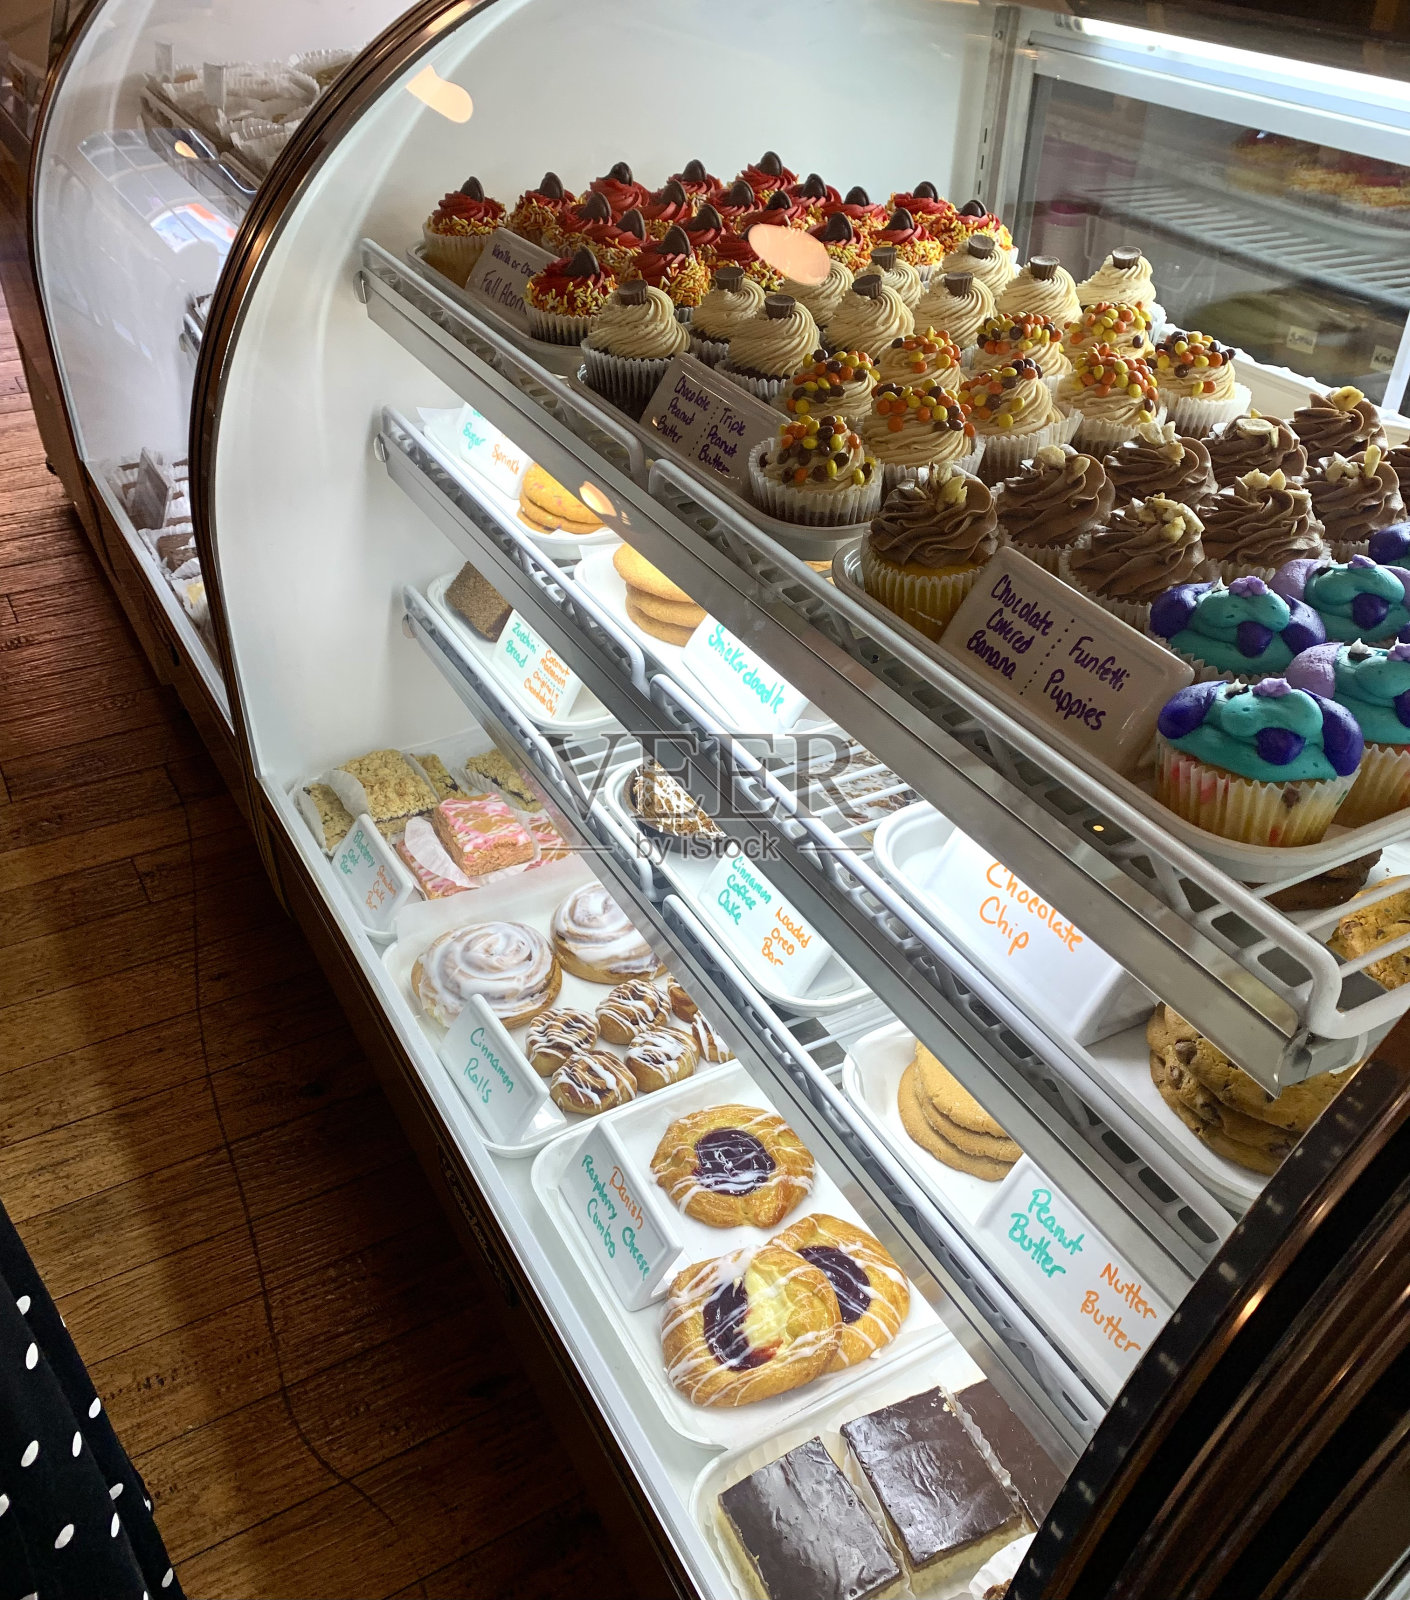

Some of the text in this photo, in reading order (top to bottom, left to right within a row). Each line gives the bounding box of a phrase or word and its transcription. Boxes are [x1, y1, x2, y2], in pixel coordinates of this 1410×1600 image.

[480, 270, 503, 298] Fall
[511, 260, 520, 270] or
[668, 397, 696, 425] Peanut
[674, 375, 711, 411] Chocolate
[463, 421, 486, 450] Sugar
[657, 415, 683, 443] Butter
[706, 425, 737, 457] Peanut
[720, 408, 745, 436] Triple
[698, 443, 730, 473] Butter
[990, 573, 1054, 636] Chocolate
[505, 639, 528, 668] Bread
[512, 621, 540, 654] Zucchini
[986, 608, 1035, 654] Covered
[966, 629, 1017, 680] Banana
[1068, 635, 1130, 692] Funfetti
[1043, 668, 1106, 731] Puppies
[726, 874, 757, 910] Coffee
[732, 855, 772, 904] Cinnamon
[717, 888, 742, 926] Cake
[775, 906, 812, 948] Loaded
[979, 896, 1029, 956] Chip
[986, 861, 1084, 953] Chocolate
[761, 936, 784, 966] Bar
[771, 927, 795, 956] Oreo
[464, 1057, 492, 1104] Rolls
[470, 1027, 514, 1094] Cinnamon
[581, 1154, 618, 1220] Raspberry
[609, 1165, 644, 1230] Danish
[587, 1197, 616, 1259] Combo
[1028, 1188, 1085, 1255] Peanut
[621, 1226, 650, 1281] Cheese
[1008, 1213, 1067, 1278] Butter
[1100, 1262, 1157, 1319] Nutter
[1080, 1290, 1142, 1352] Butter
